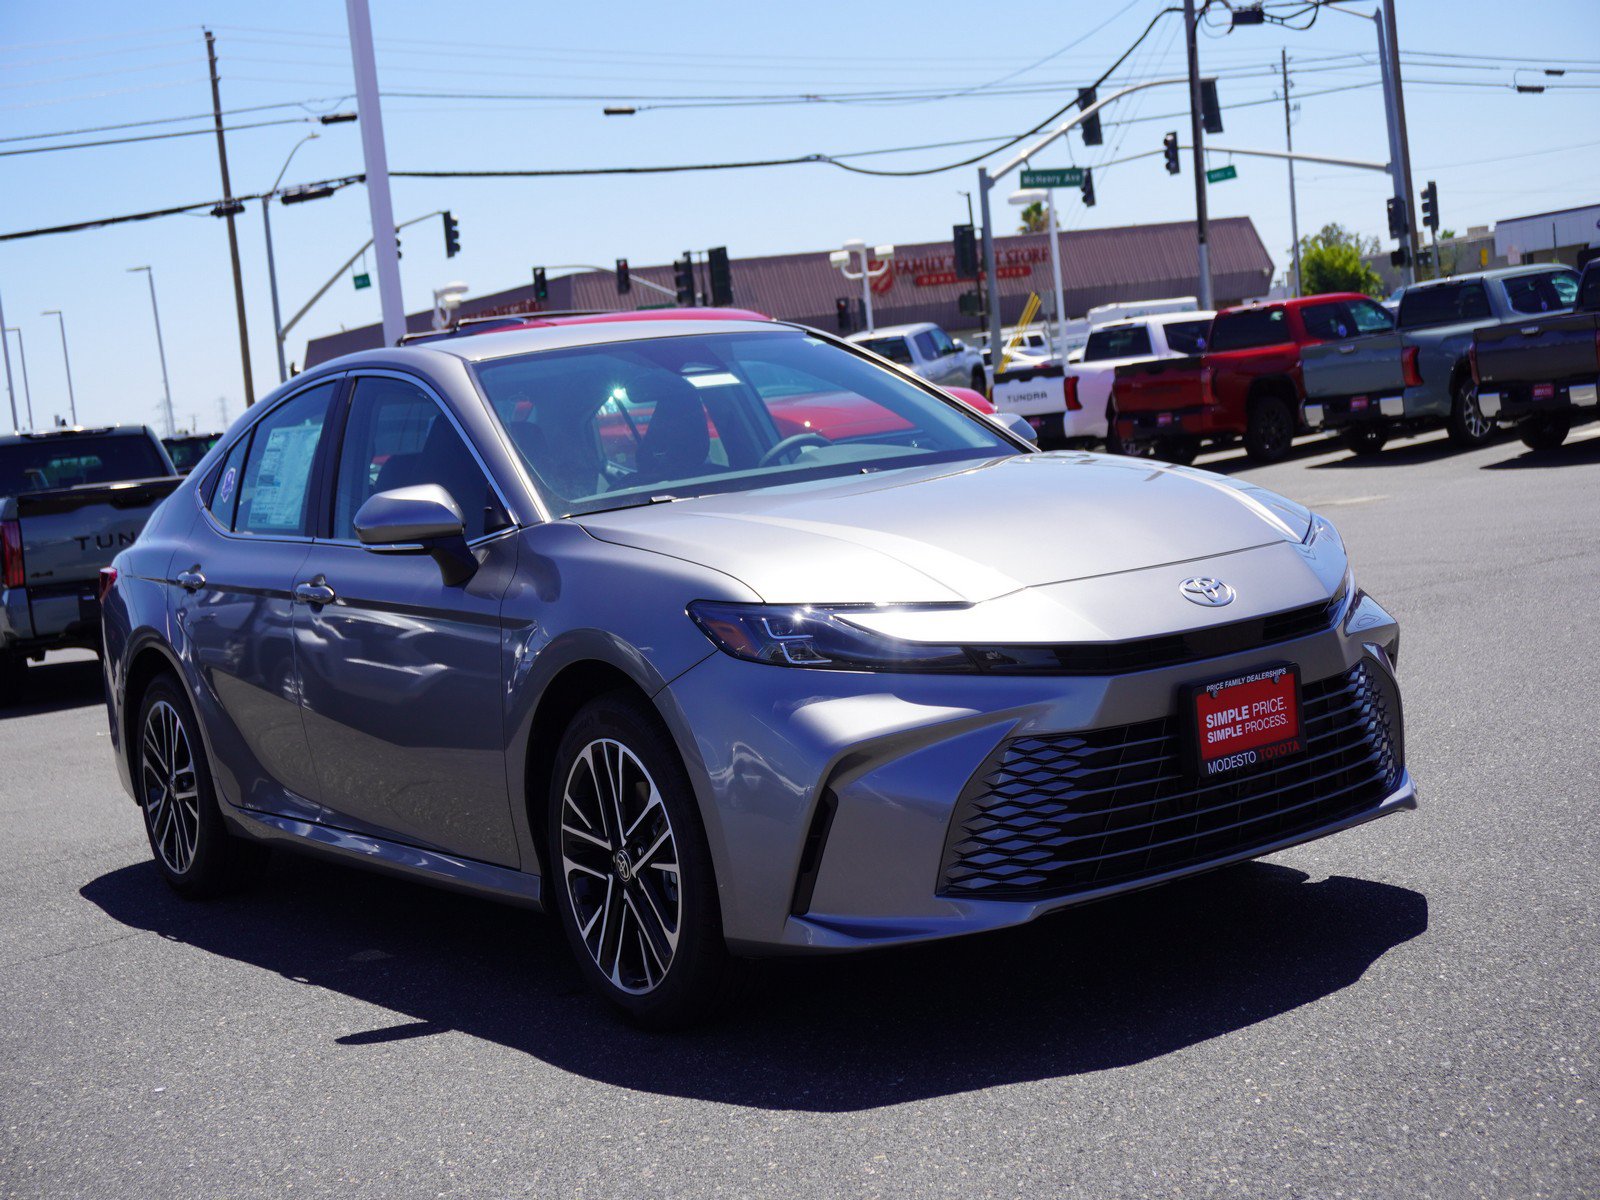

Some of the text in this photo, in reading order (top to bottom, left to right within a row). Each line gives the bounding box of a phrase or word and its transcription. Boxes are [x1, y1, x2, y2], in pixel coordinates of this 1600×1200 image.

[1023, 174, 1061, 185] McHenry
[894, 255, 945, 275] FAMILY
[1006, 247, 1050, 265] STORE
[1007, 391, 1048, 403] TUNDRA
[74, 531, 136, 550] TUN
[1206, 668, 1287, 693] PRICE FAMILY DEALERSHIPS
[1206, 696, 1288, 728] SIMPLE PRICE.
[1207, 713, 1289, 744] SIMPLE PROCESS.
[1207, 740, 1300, 775] MODESTO TOYOTA
